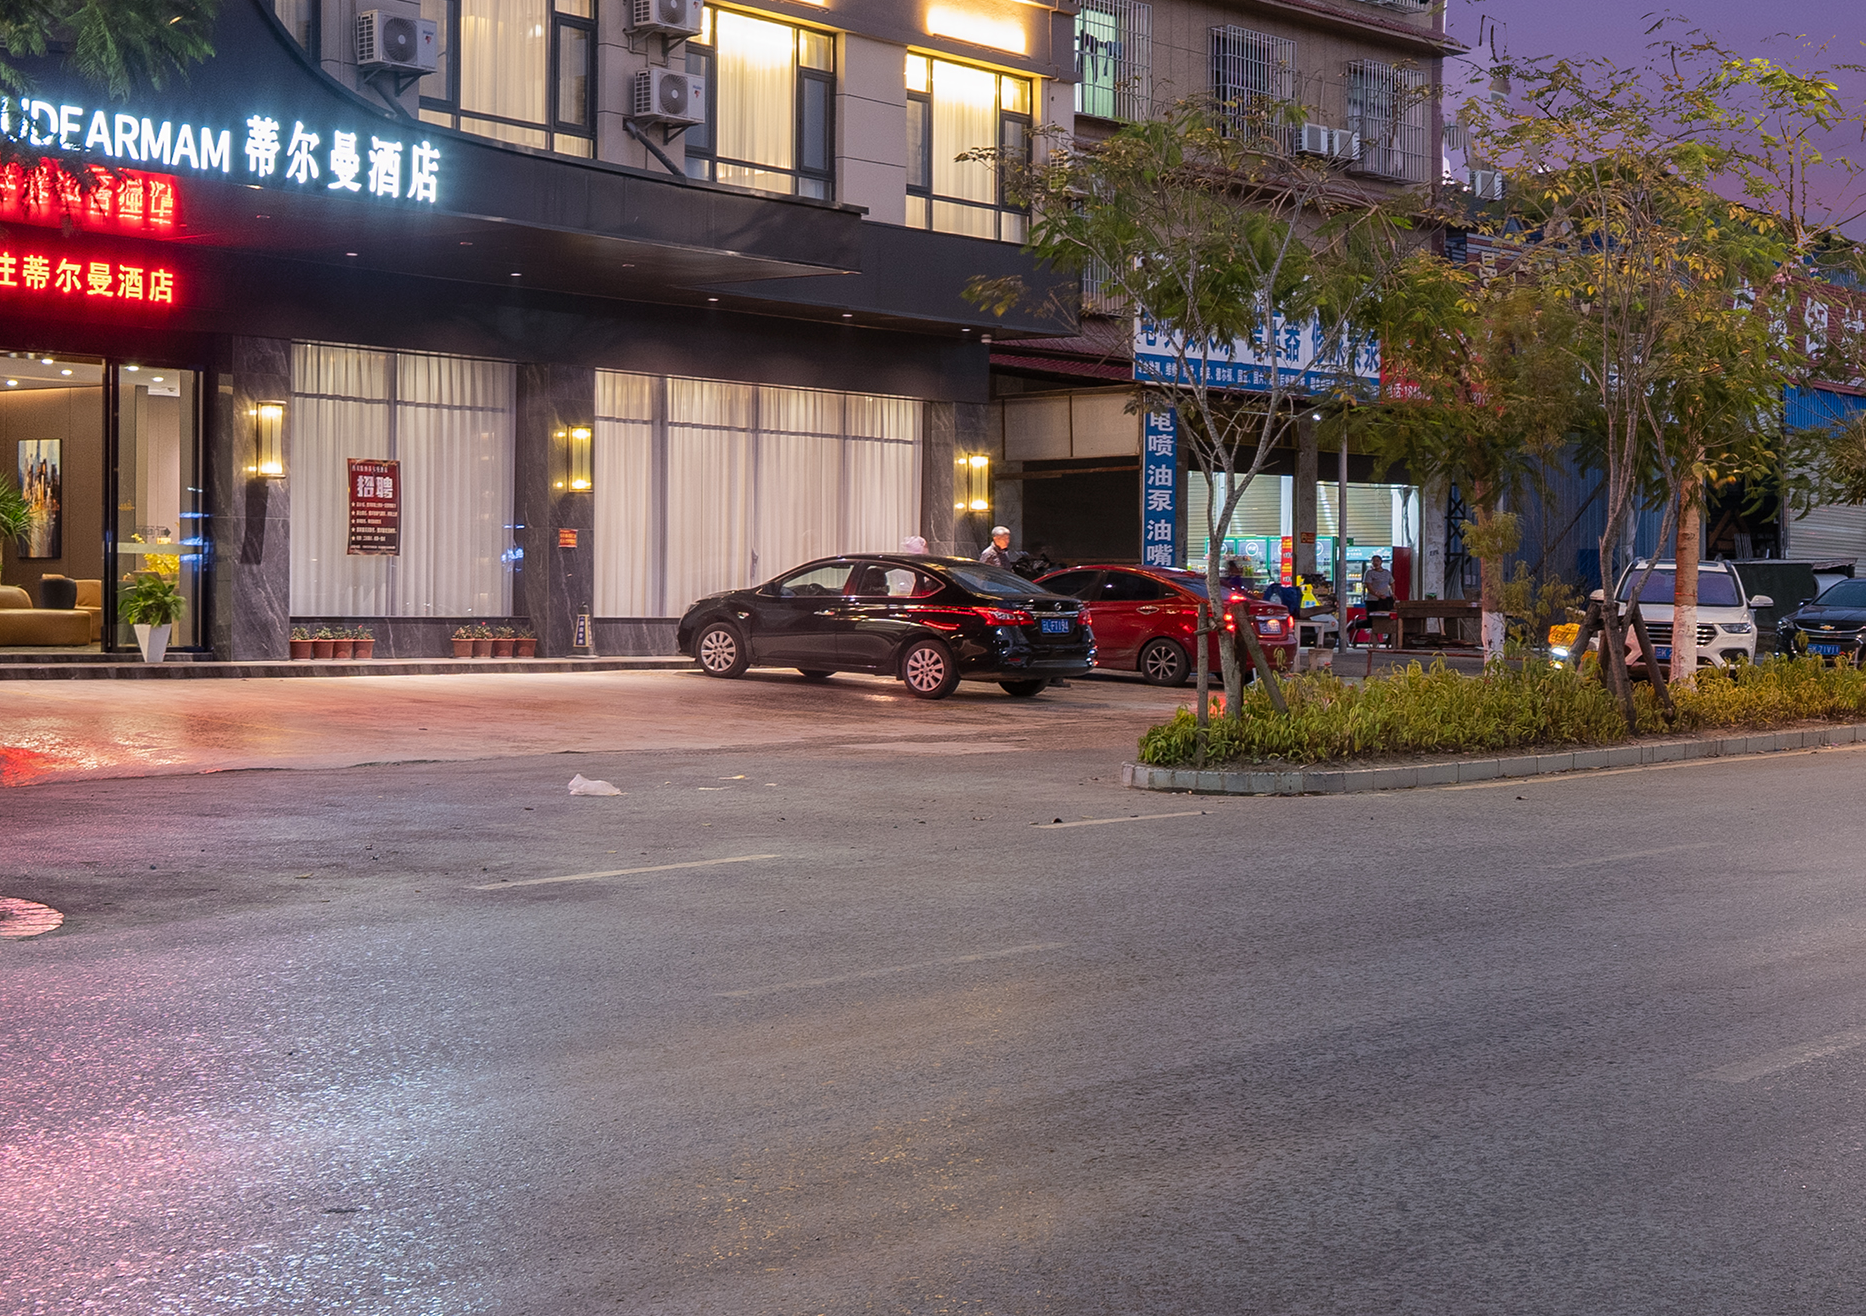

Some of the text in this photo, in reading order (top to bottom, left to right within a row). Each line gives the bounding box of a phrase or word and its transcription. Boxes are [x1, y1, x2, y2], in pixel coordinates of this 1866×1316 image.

[244, 114, 441, 203] 蒂尔曼酒店
[356, 475, 393, 499] 招聘
